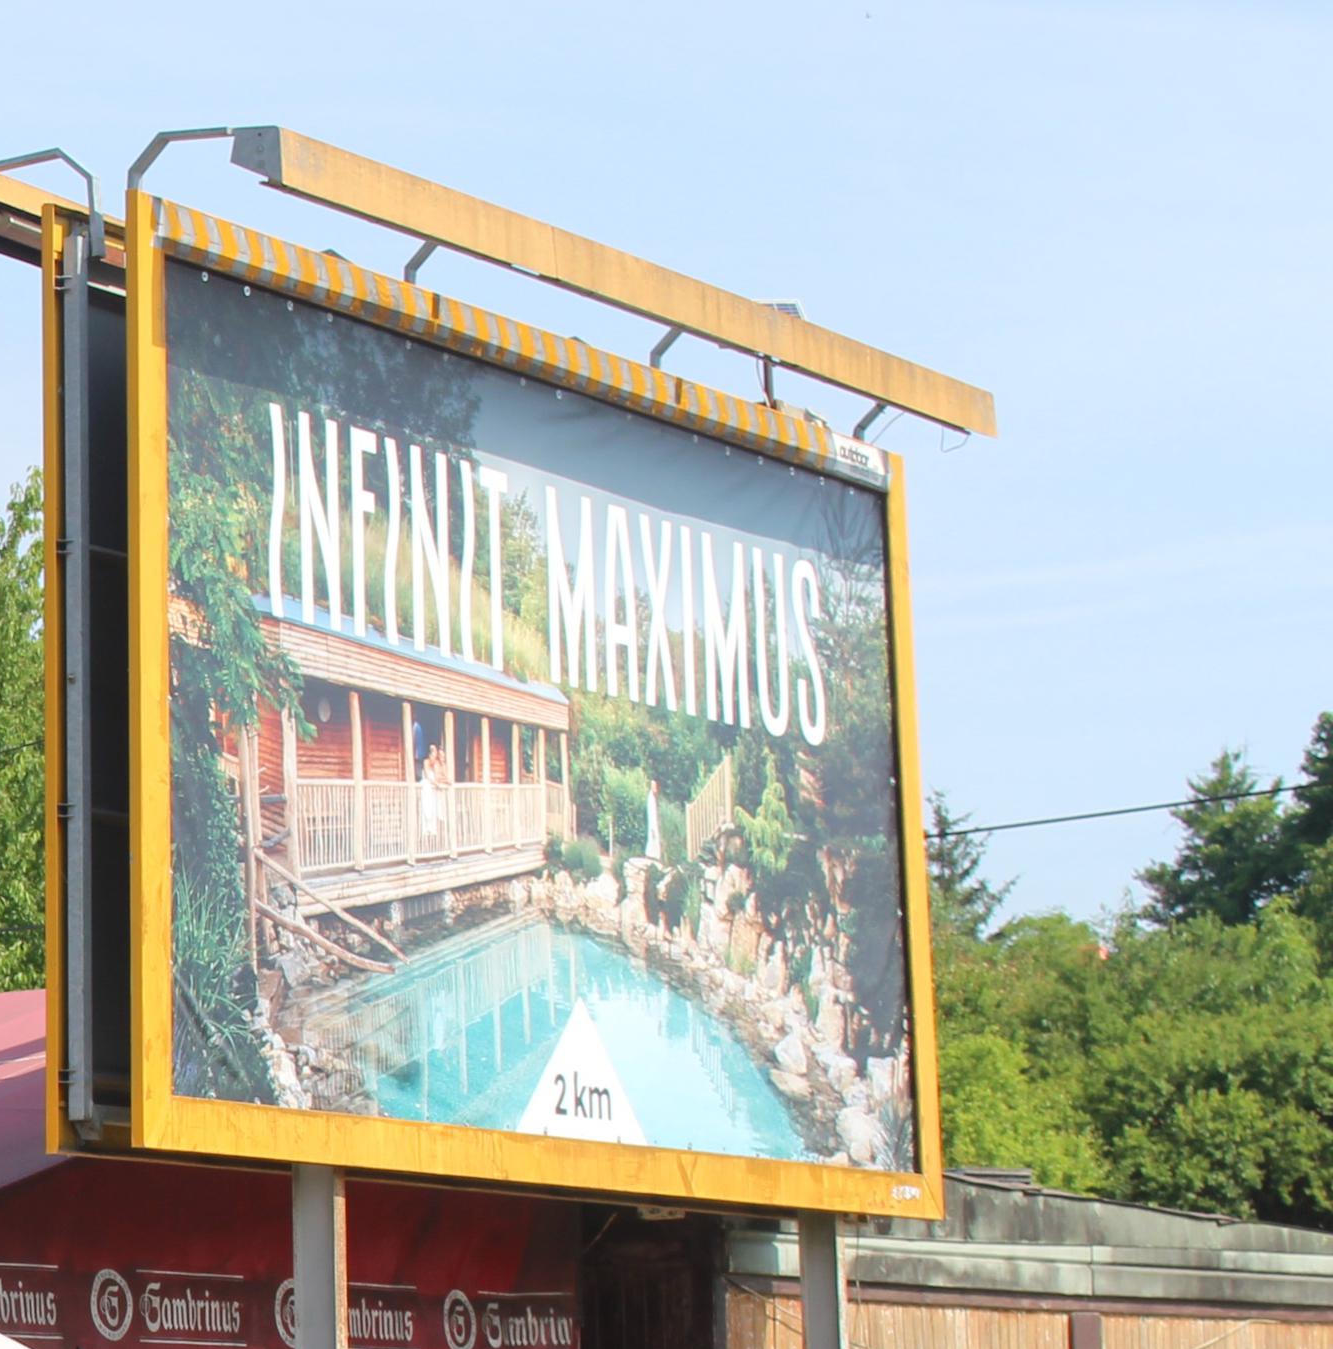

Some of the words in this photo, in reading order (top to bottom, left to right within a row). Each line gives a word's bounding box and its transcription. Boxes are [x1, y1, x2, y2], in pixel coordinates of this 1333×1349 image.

[267, 402, 509, 672] INFINIT
[545, 484, 827, 747] MAXIMUS
[553, 1073, 569, 1117] 2
[572, 1070, 612, 1121] km
[139, 1282, 240, 1333] Gambrinus
[348, 1297, 414, 1342] mbrinus
